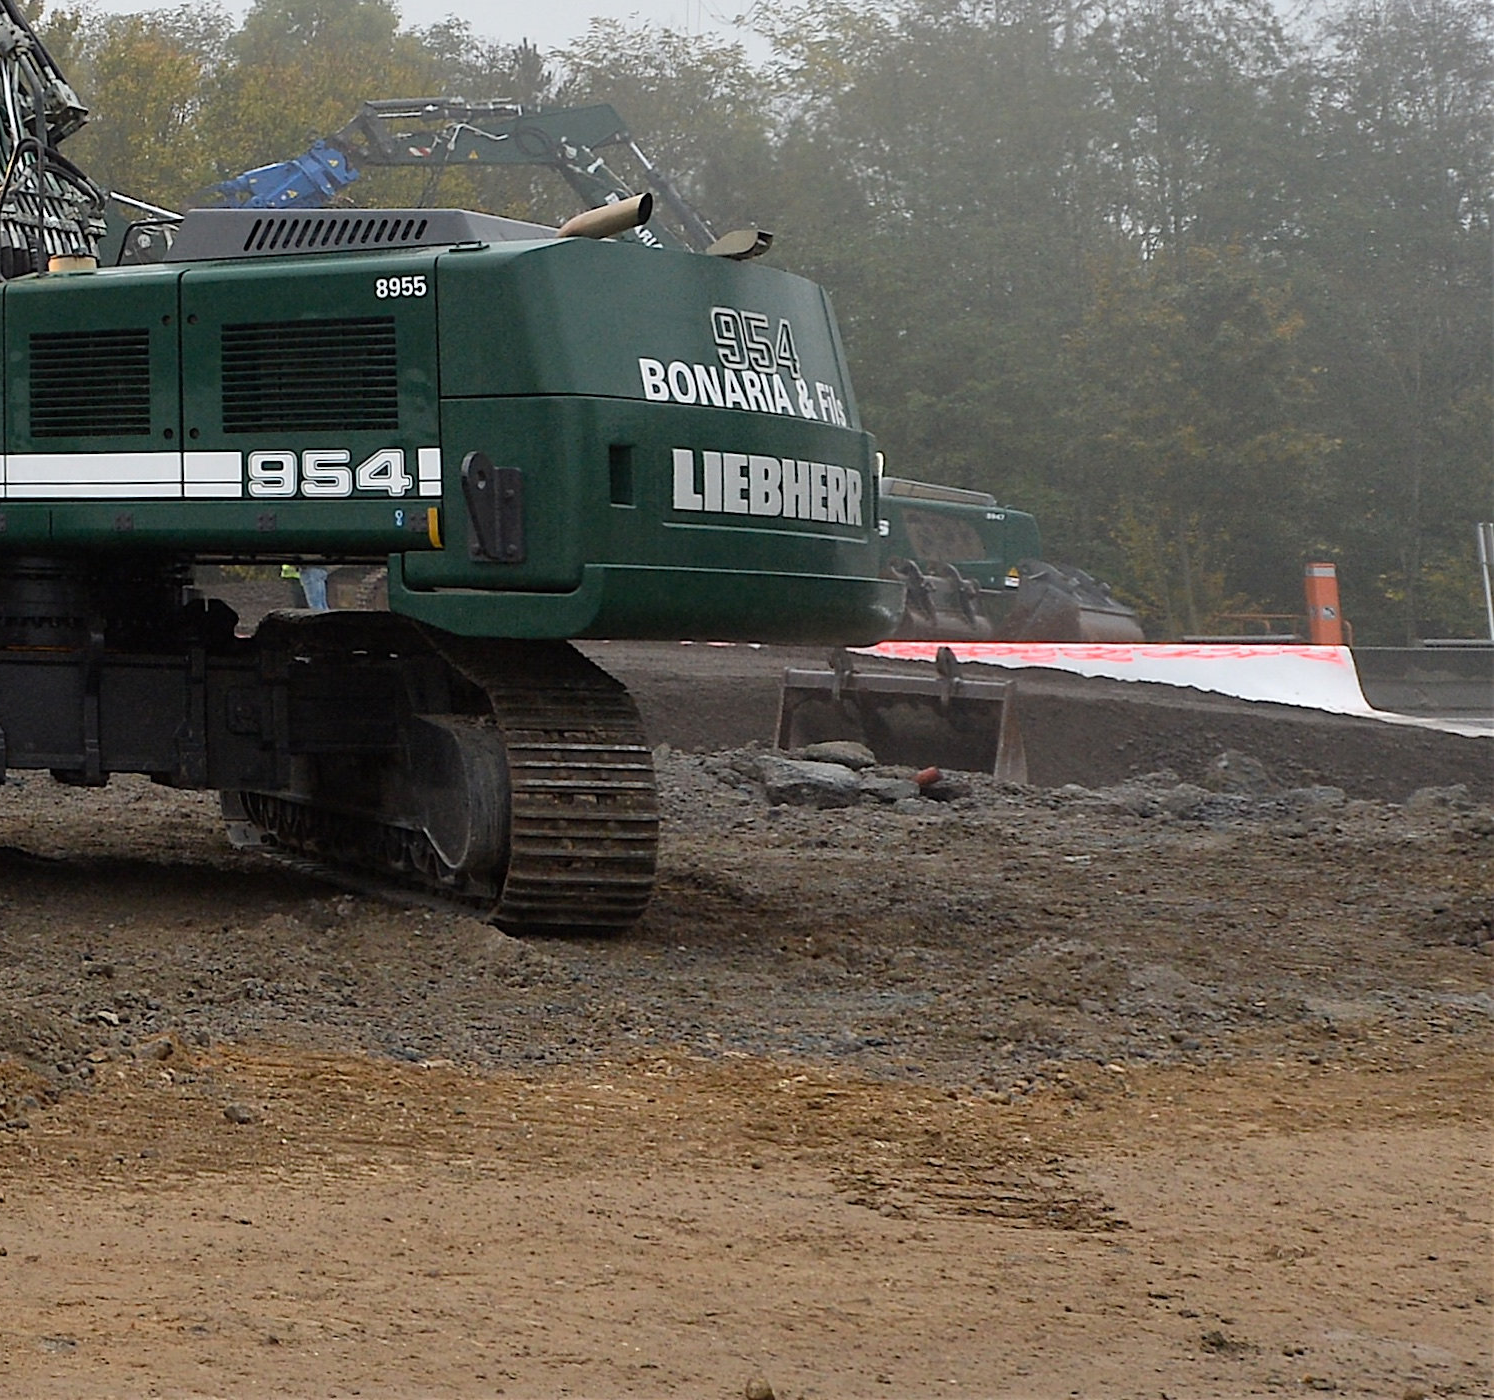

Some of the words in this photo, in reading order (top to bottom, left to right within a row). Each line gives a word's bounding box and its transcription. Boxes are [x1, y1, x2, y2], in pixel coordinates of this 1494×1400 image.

[375, 275, 427, 299] 8955
[711, 306, 802, 379] 954
[638, 357, 795, 416] BONARIA
[795, 378, 818, 420] &
[815, 381, 847, 427] Fils
[247, 449, 413, 497] 954
[672, 448, 862, 526] LIEBHERR
